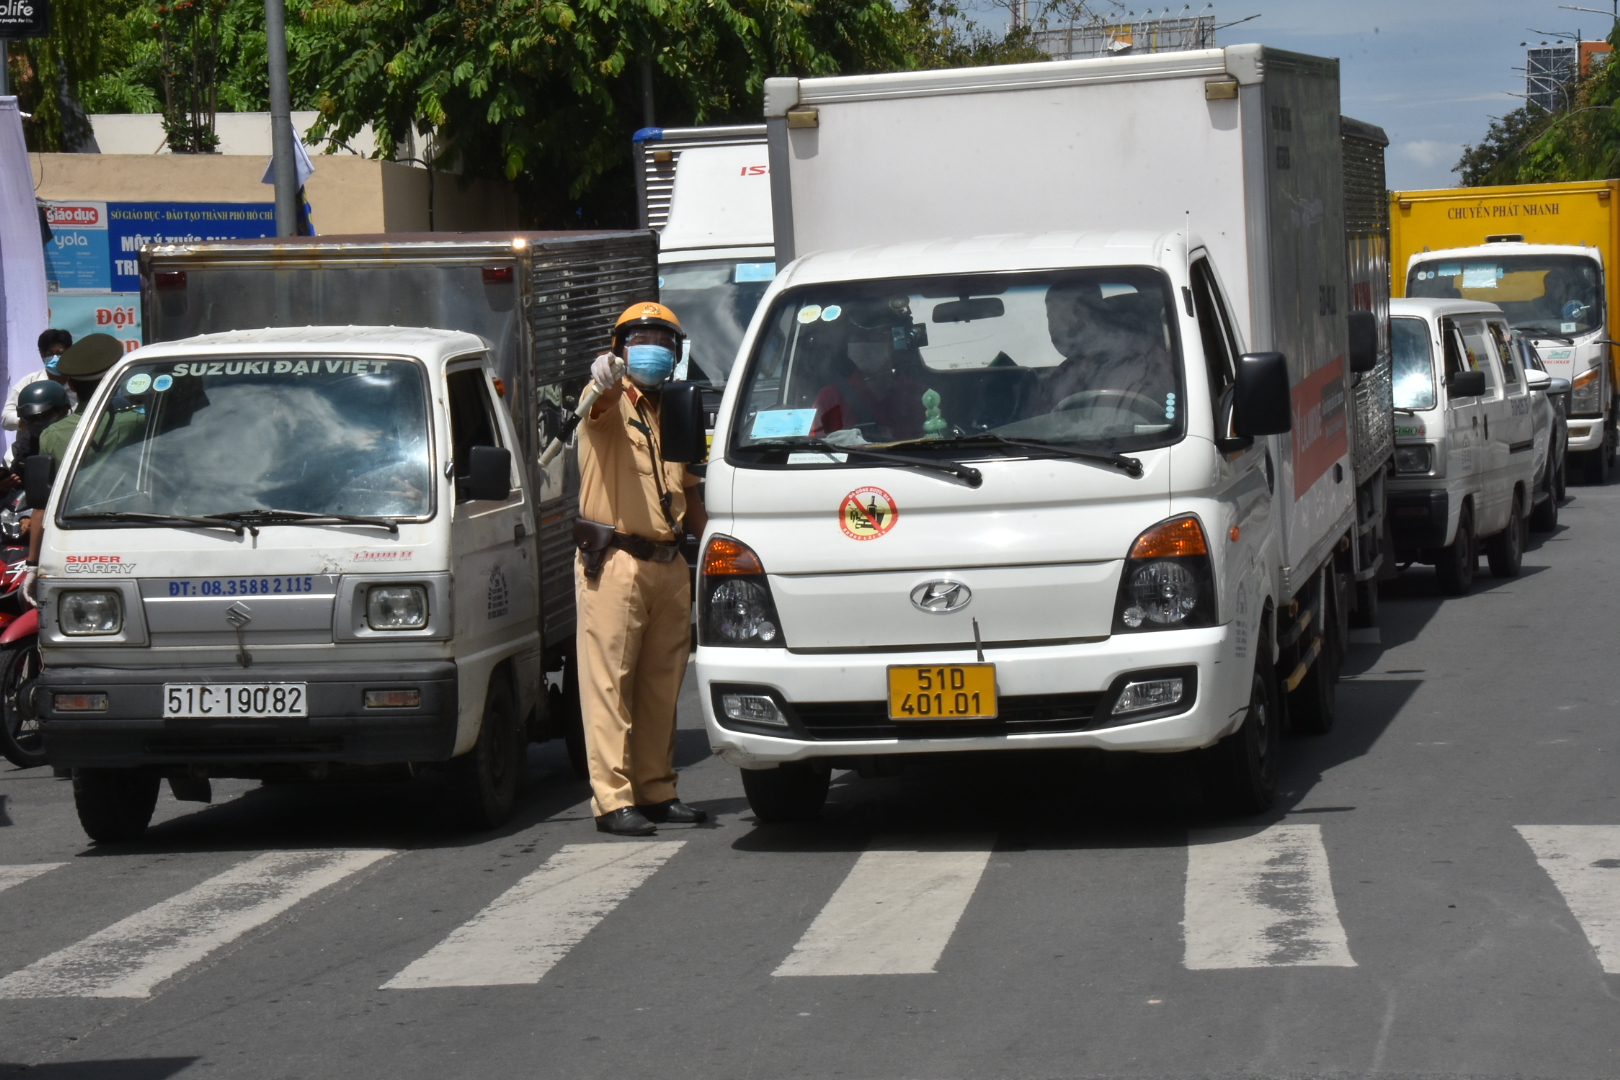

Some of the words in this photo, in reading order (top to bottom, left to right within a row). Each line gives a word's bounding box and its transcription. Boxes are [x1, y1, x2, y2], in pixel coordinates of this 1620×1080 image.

[741, 165, 771, 176] IS
[122, 208, 143, 220] GIÁO
[143, 210, 160, 222] DỤC
[184, 210, 200, 222] TẠO
[201, 208, 228, 220] THÀNH
[1447, 201, 1490, 219] CHUYỂN
[1493, 202, 1519, 217] PHÁT
[1523, 203, 1560, 216] NHANH
[54, 231, 88, 249] yola
[96, 307, 135, 329] Đội
[172, 362, 269, 377] SUZUKI
[274, 360, 320, 376] ĐẠI
[325, 360, 388, 377] VIỆT
[66, 555, 121, 563] SUPER
[65, 563, 136, 574] CARRY
[918, 668, 965, 690] 51D
[168, 687, 302, 714] 51C-190.82
[901, 691, 981, 715] 401.01
